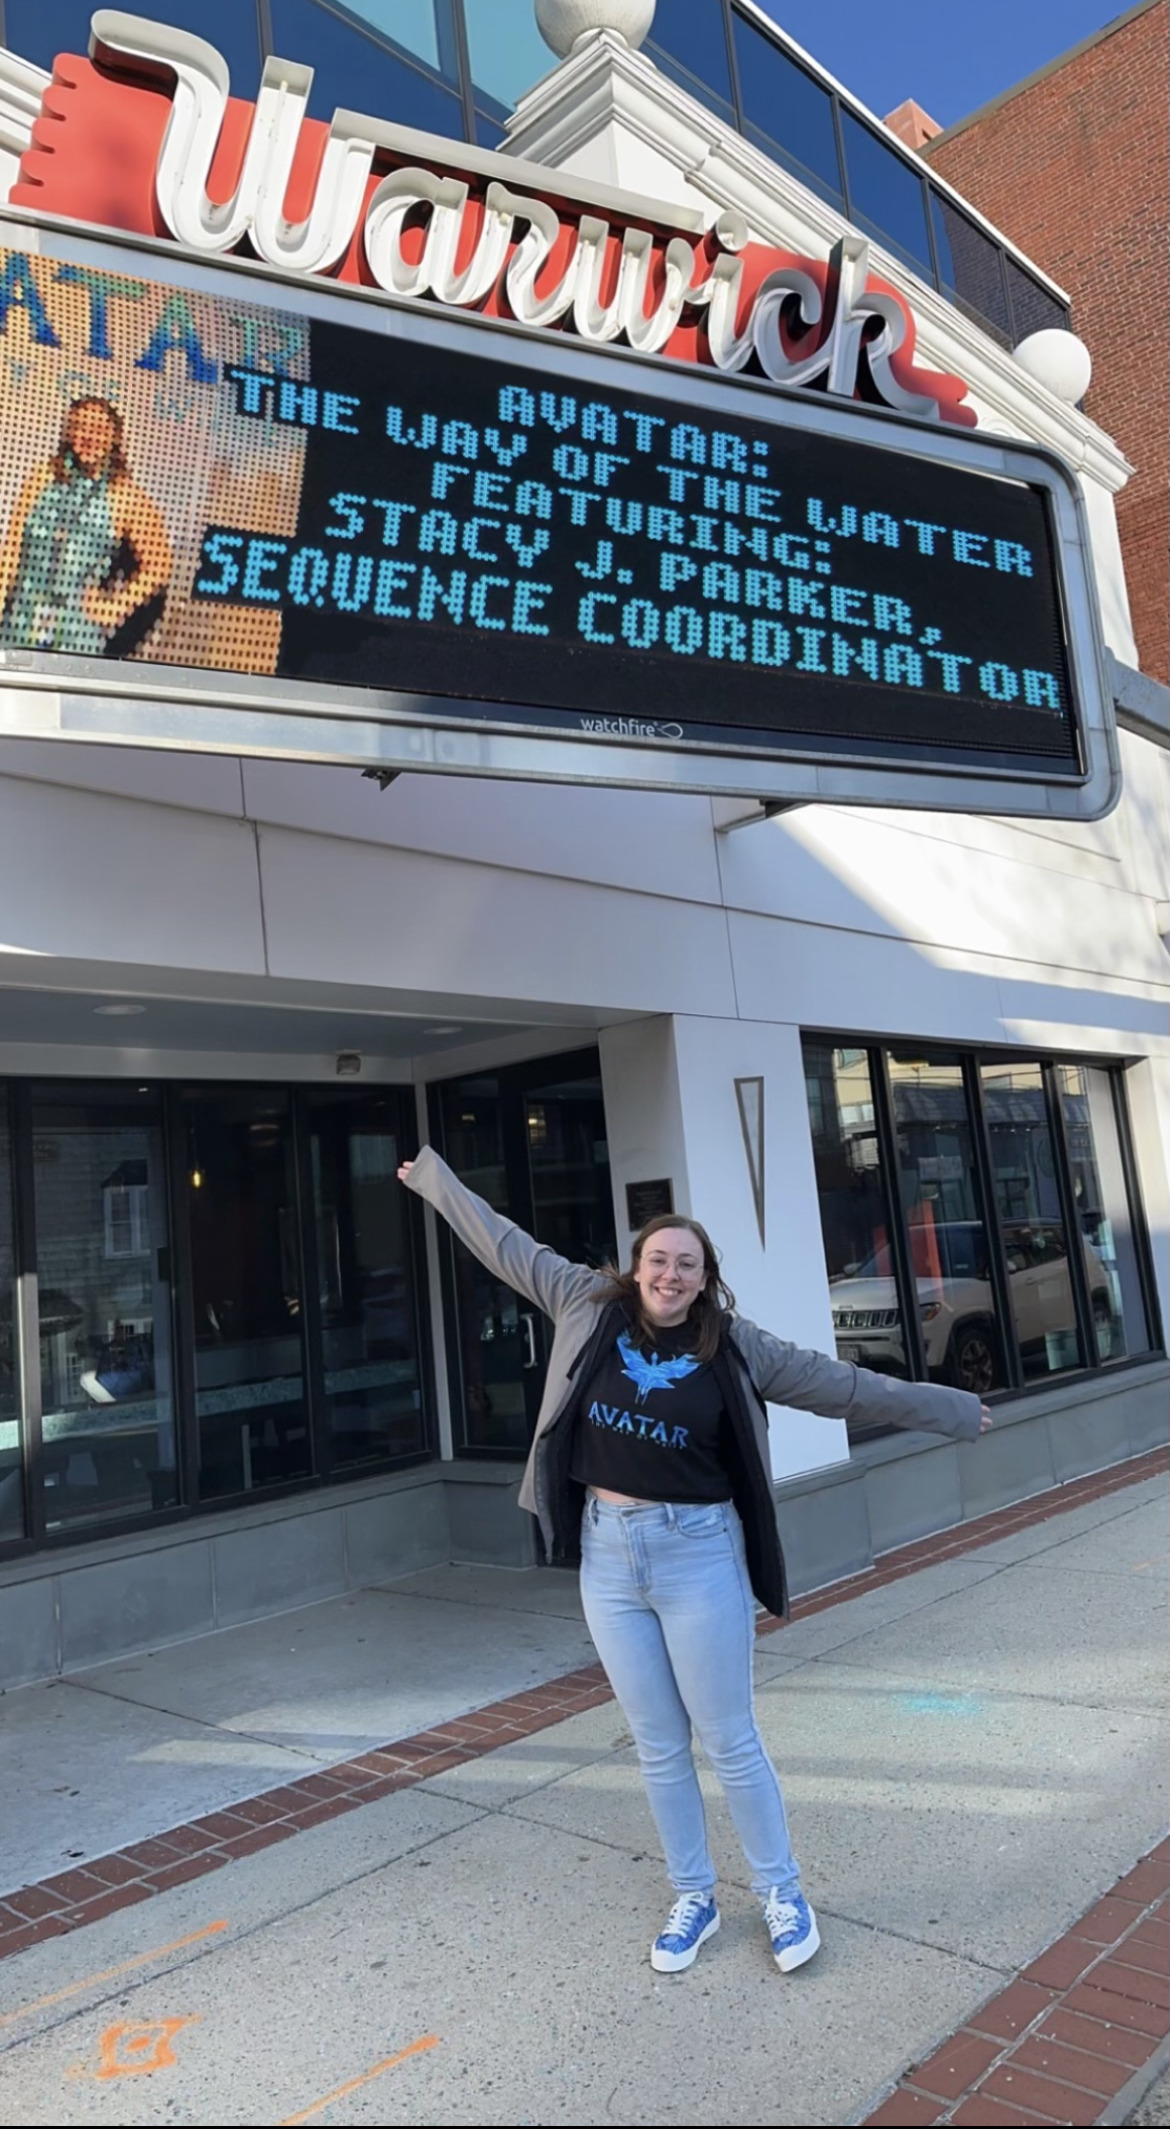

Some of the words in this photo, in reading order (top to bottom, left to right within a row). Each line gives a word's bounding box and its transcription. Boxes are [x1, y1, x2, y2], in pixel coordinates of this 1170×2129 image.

[87, 8, 941, 421] Warwick
[230, 368, 360, 434] THE
[386, 405, 527, 467] WAY
[552, 444, 630, 487] OF
[656, 464, 781, 522] THE
[807, 498, 1033, 577] WATER
[499, 385, 768, 478] AVATAR:
[325, 492, 550, 568] STACY
[575, 540, 633, 585] J.
[659, 552, 942, 645] PARKER,
[431, 461, 831, 574] FEATURING:
[197, 533, 553, 636] SEQUENCE
[577, 591, 1061, 709] COORDINATOR
[588, 1400, 689, 1448] AVATAR
